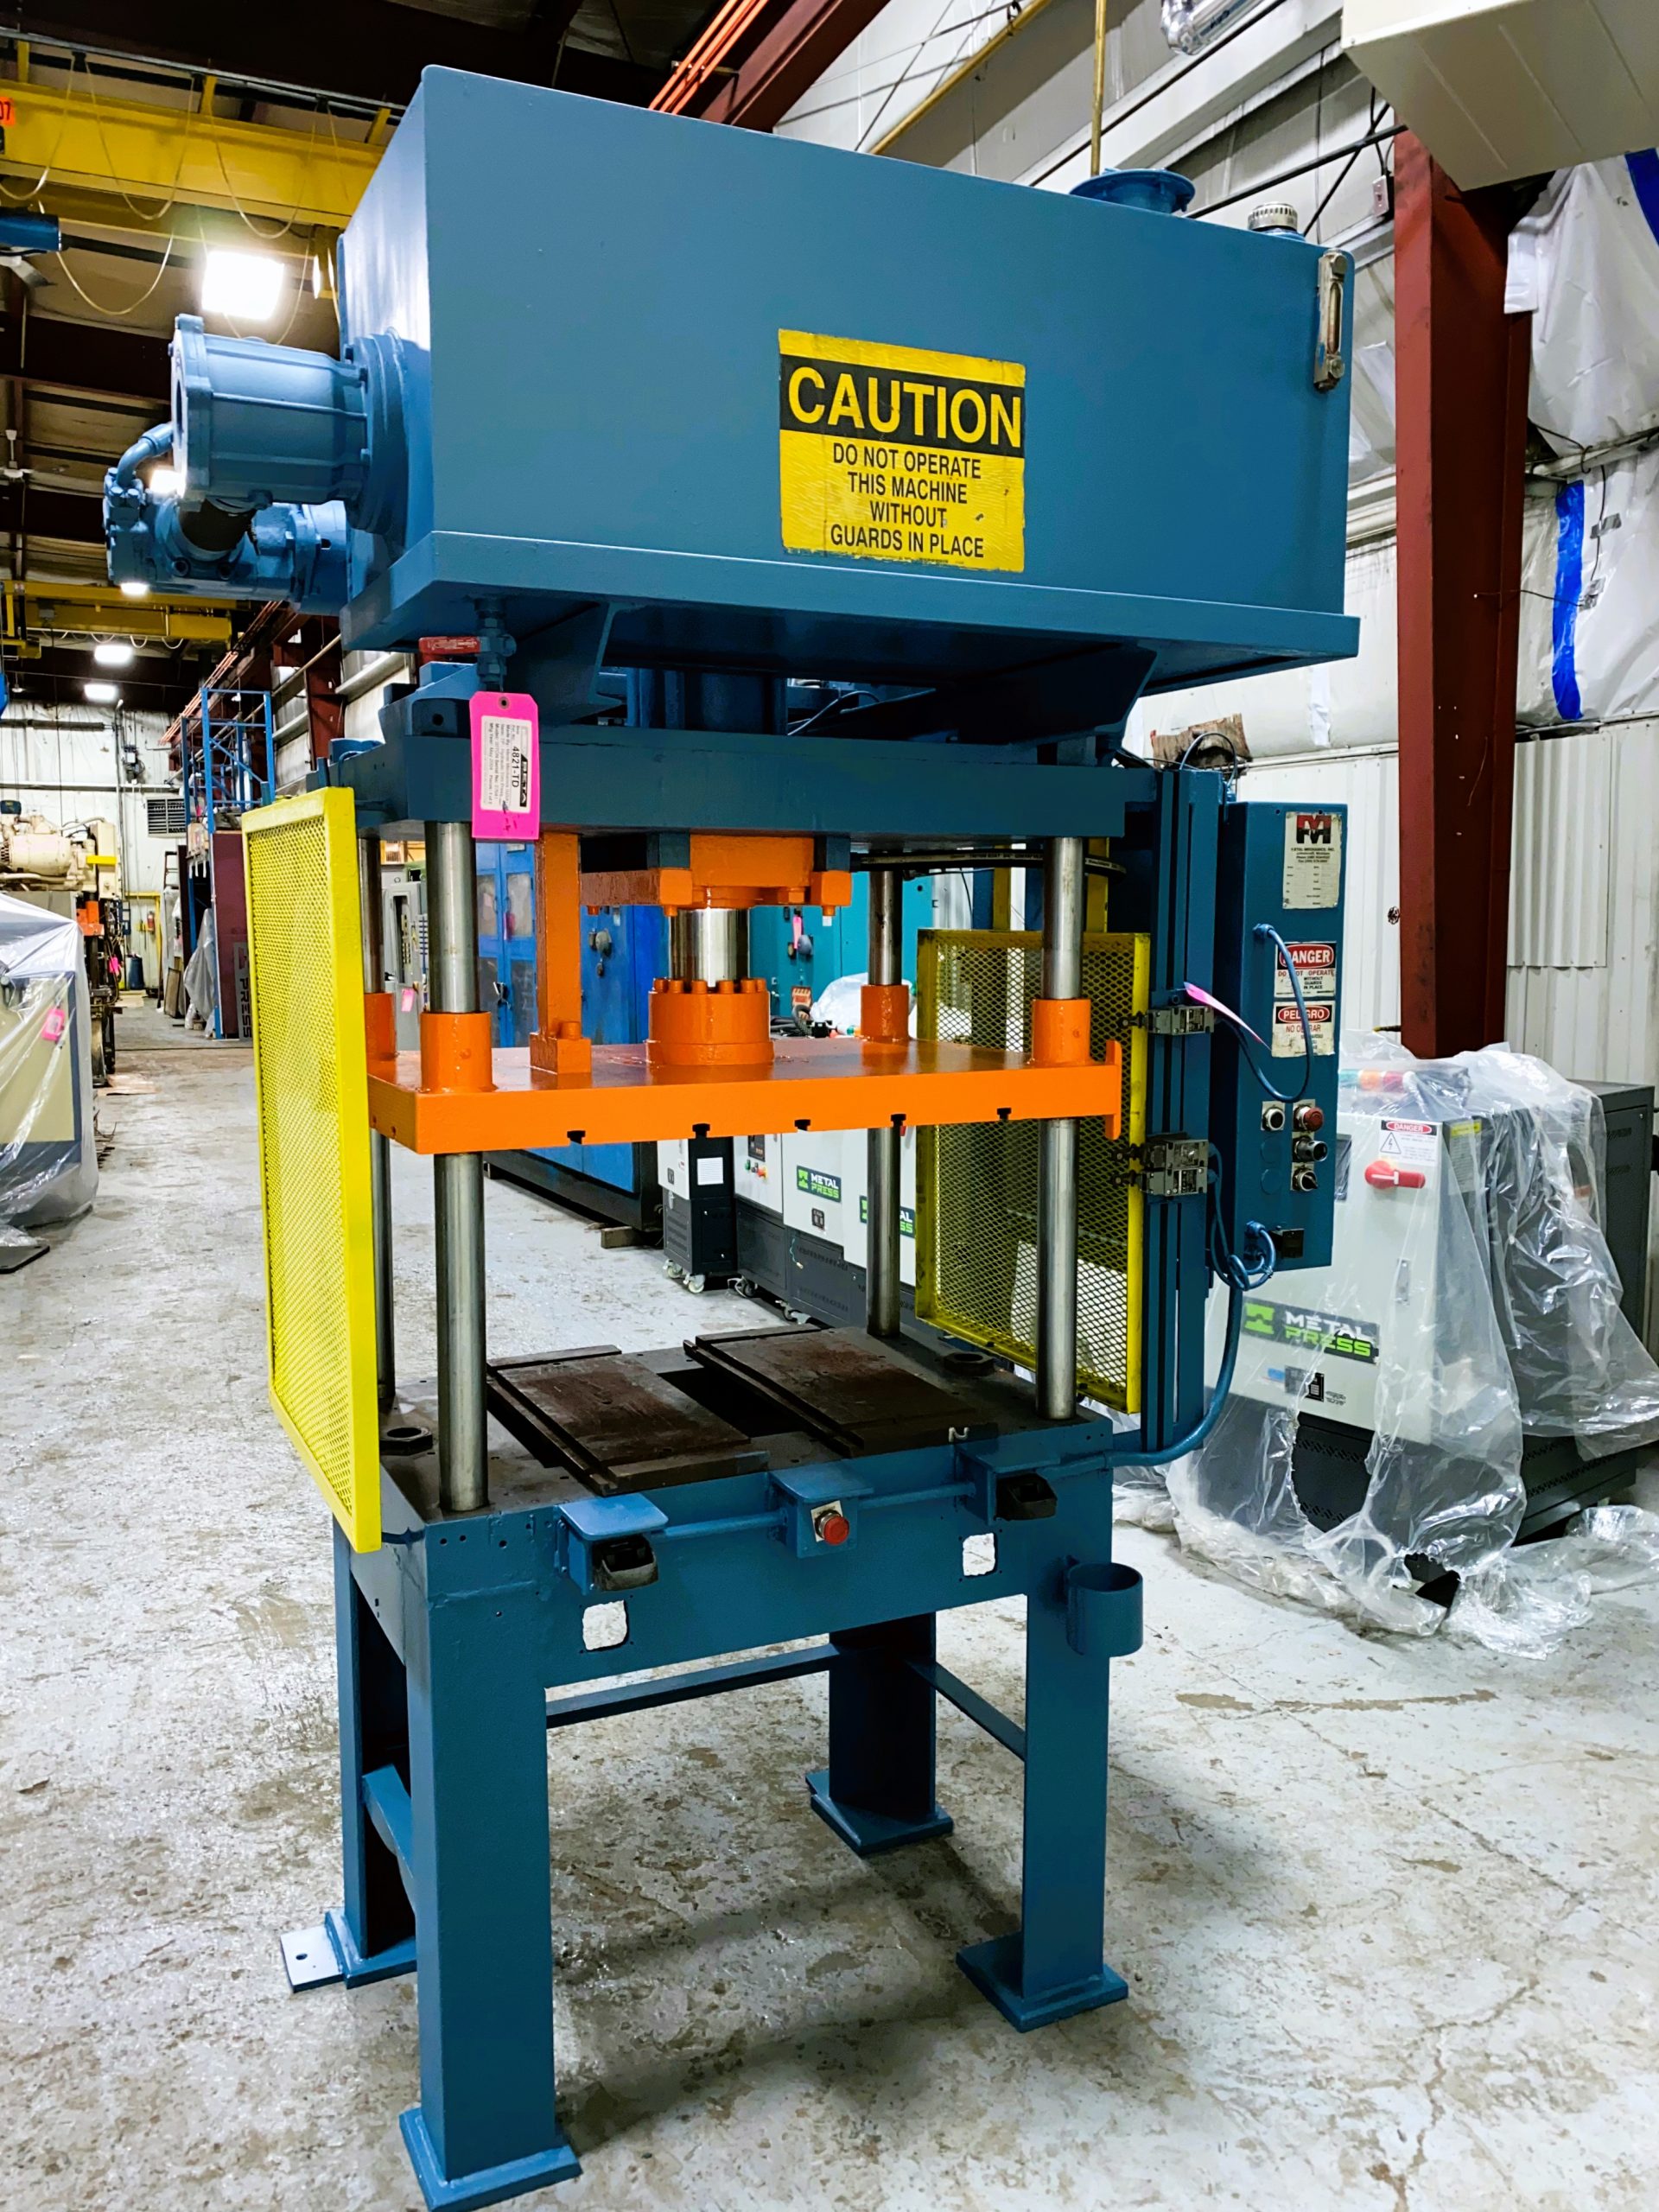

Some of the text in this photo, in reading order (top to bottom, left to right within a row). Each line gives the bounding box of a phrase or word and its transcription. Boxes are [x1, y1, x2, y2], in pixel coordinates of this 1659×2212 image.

[788, 366, 1021, 448] CAUTION
[833, 442, 982, 480] DO NOT OPERATE
[848, 472, 968, 504] THIS MACHINE
[869, 500, 947, 528] WITHOUT
[830, 524, 984, 558] GUARDS IN PLACE
[512, 746, 520, 788] 4821-TD
[1283, 950, 1331, 964] ANGER
[1308, 969, 1334, 977] OPERATE
[240, 977, 251, 1038] PRESS
[1283, 1009, 1325, 1020] PELGRO
[1394, 1122, 1423, 1132] DANGER
[811, 1173, 839, 1189] METAL
[811, 1181, 839, 1198] PRESS
[1285, 1311, 1374, 1343] METAL
[1285, 1325, 1371, 1357] PRESS
